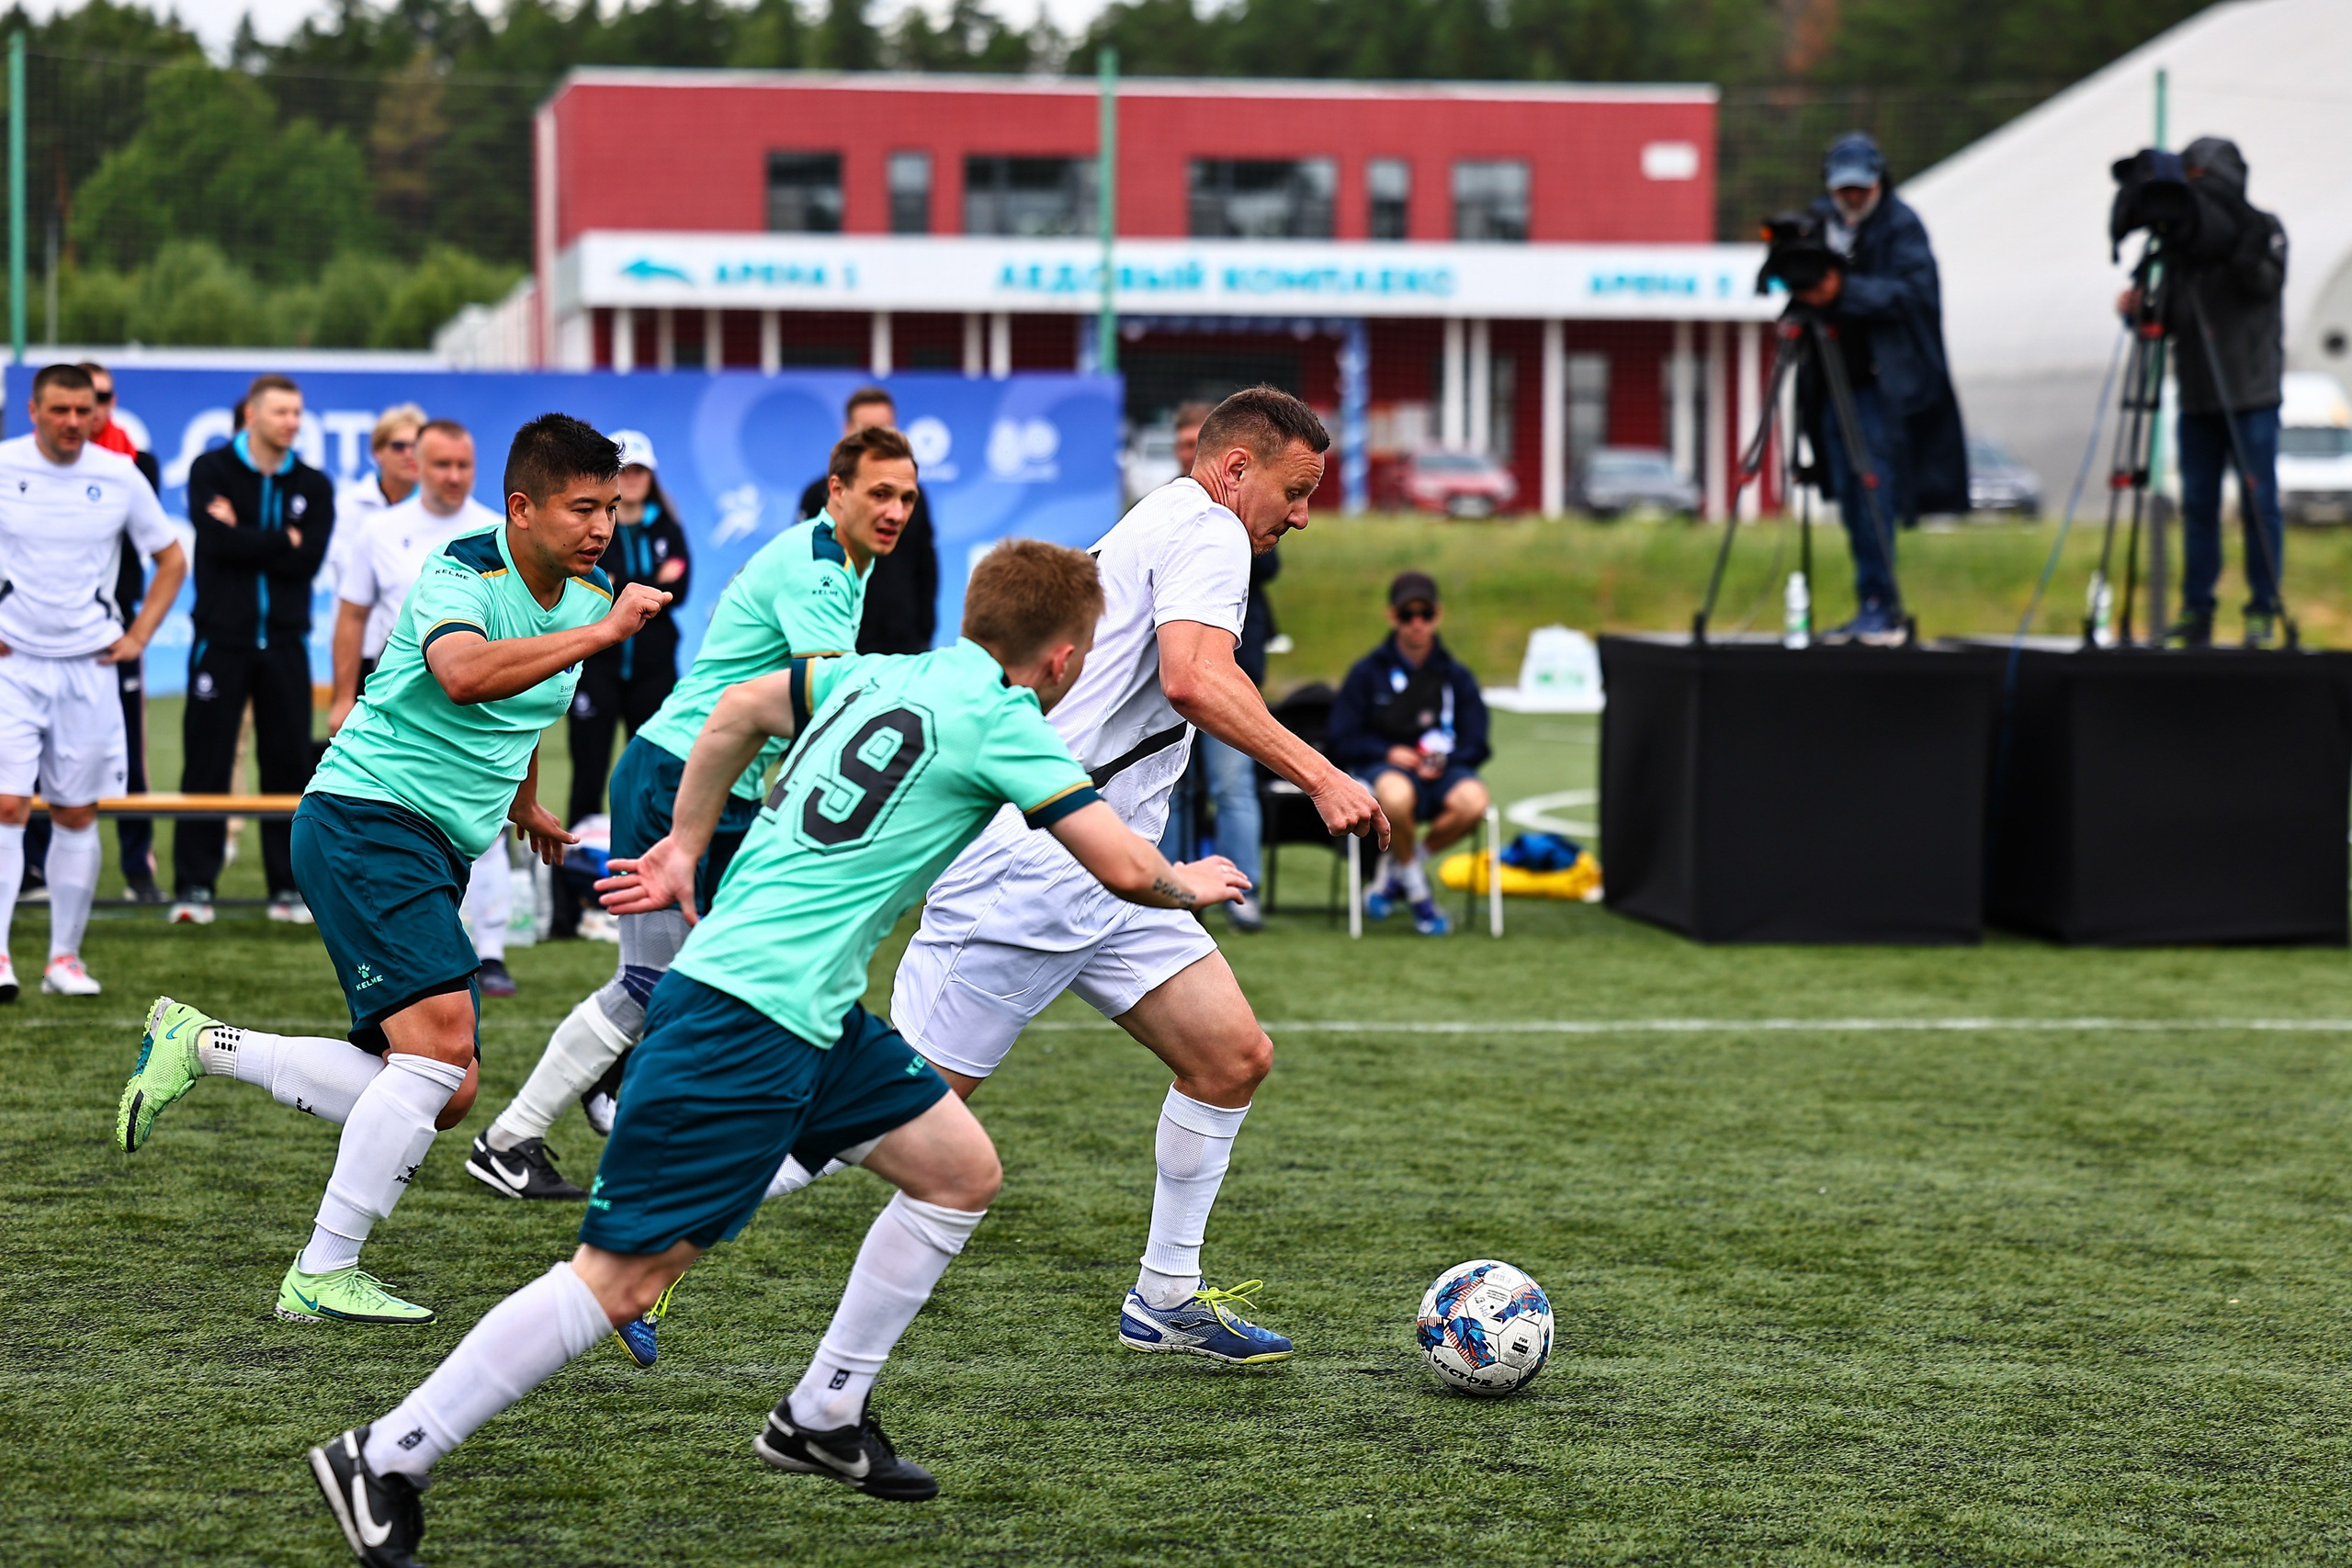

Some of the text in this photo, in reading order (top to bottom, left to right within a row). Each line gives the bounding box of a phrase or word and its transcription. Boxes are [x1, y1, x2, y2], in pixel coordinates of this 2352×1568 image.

[435, 569, 469, 581] KELME
[759, 678, 938, 856] 19
[356, 975, 384, 991] KELME
[1433, 1354, 1493, 1386] VECTOR
